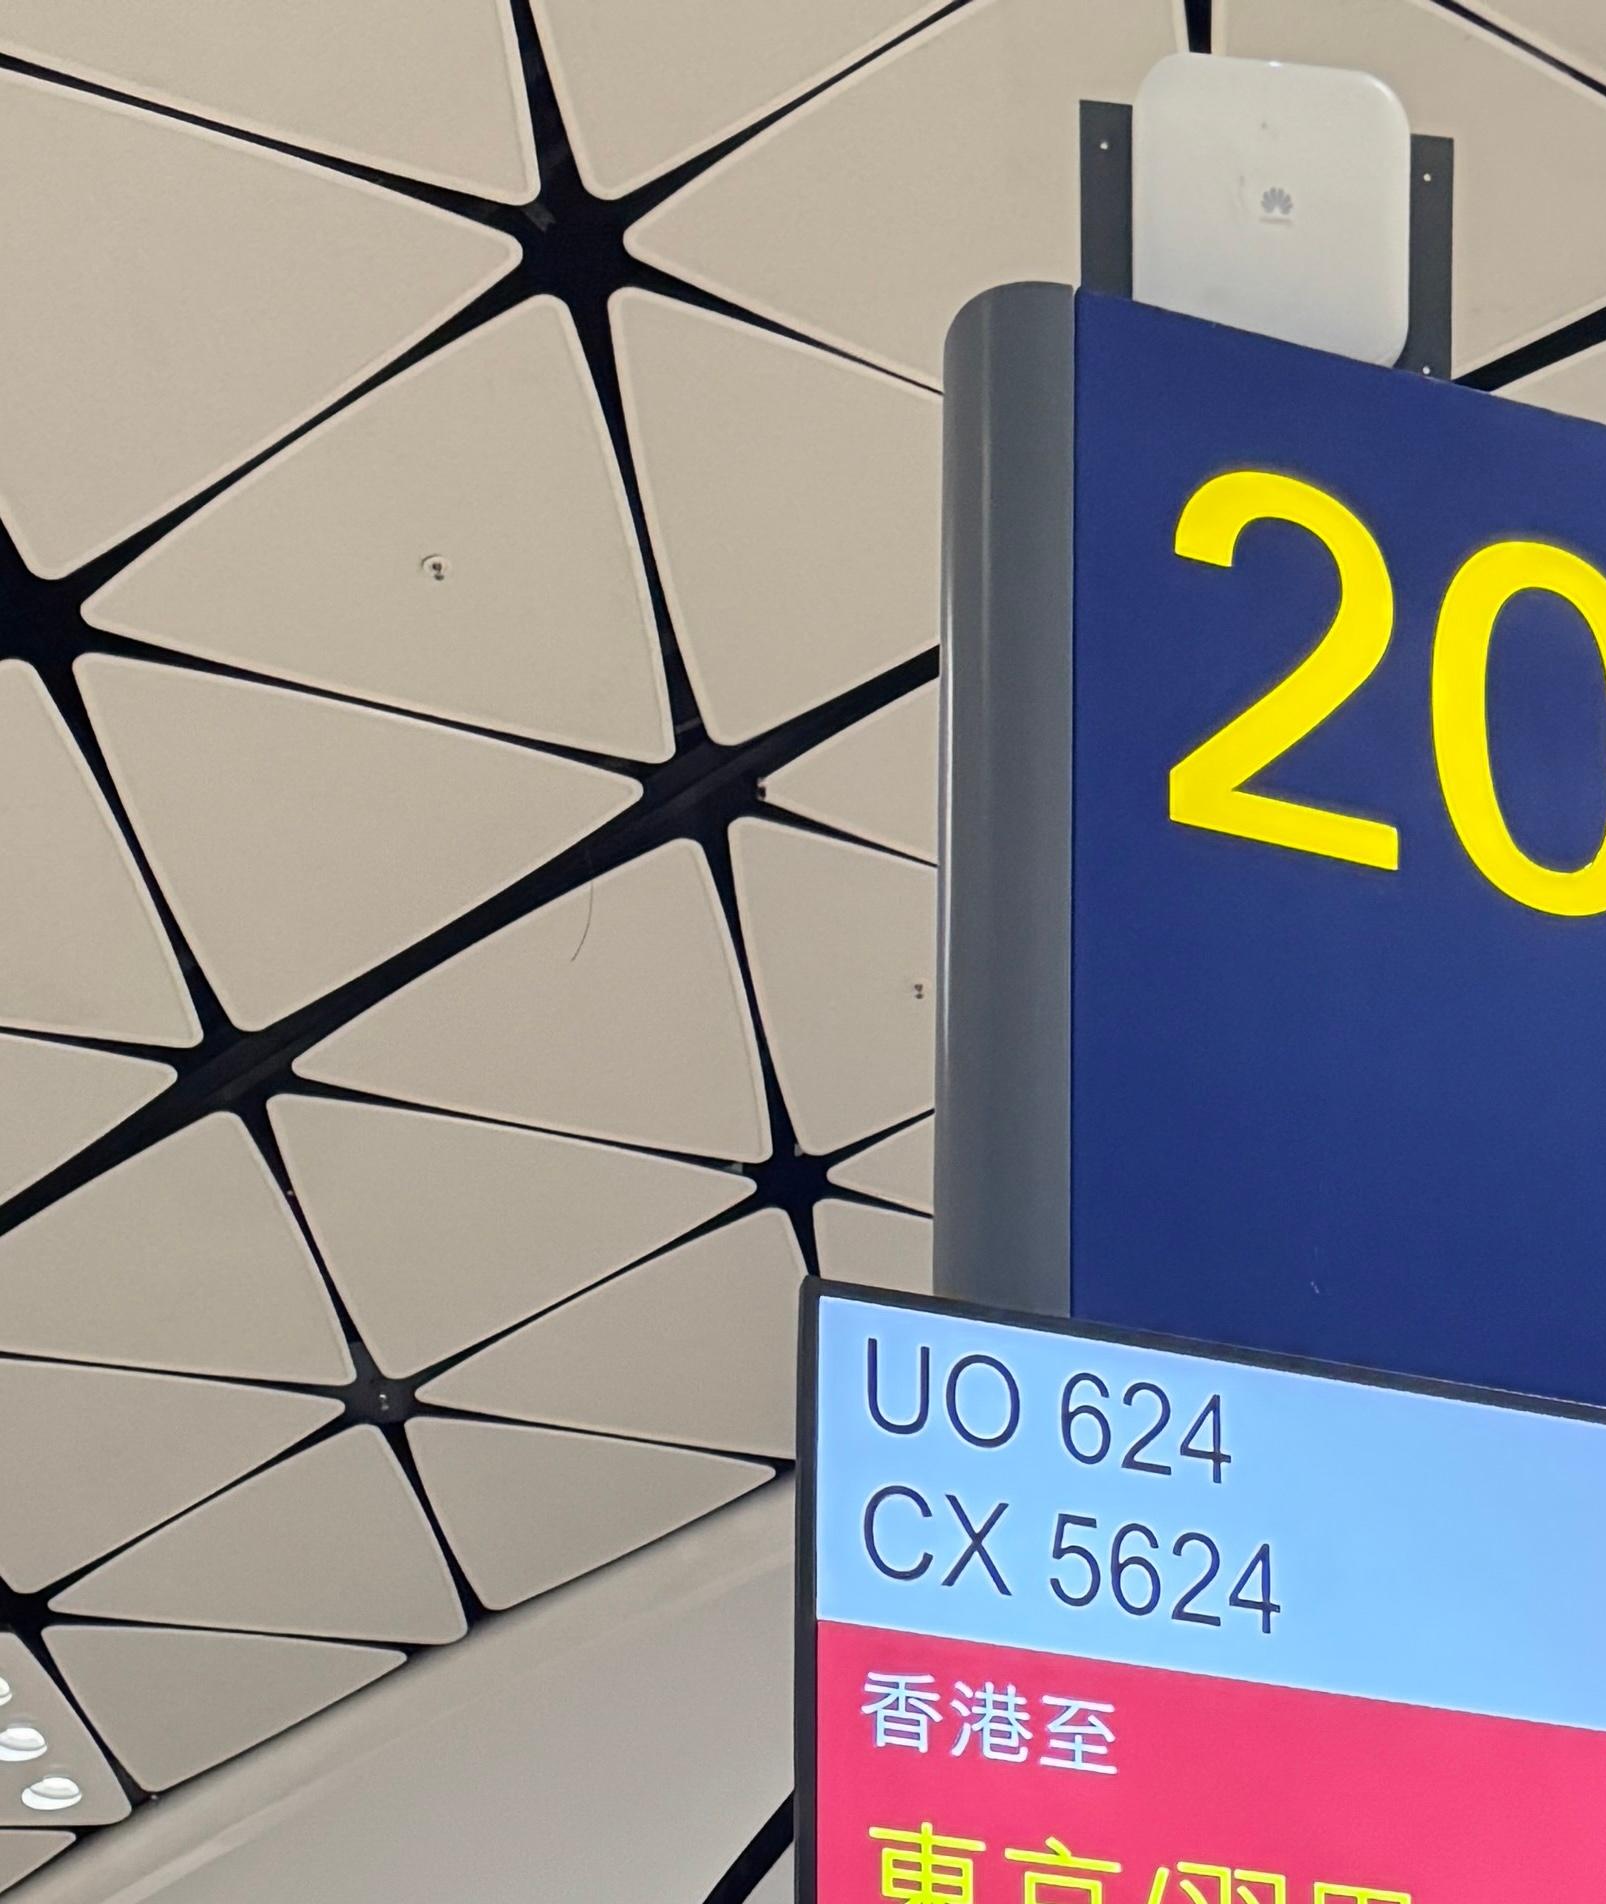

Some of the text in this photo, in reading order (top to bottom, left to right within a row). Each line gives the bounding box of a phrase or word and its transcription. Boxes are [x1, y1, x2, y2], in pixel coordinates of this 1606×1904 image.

[866, 1337, 1233, 1485] UO 624
[862, 1485, 1282, 1635] CX 5624
[860, 1671, 1118, 1776] 香港至
